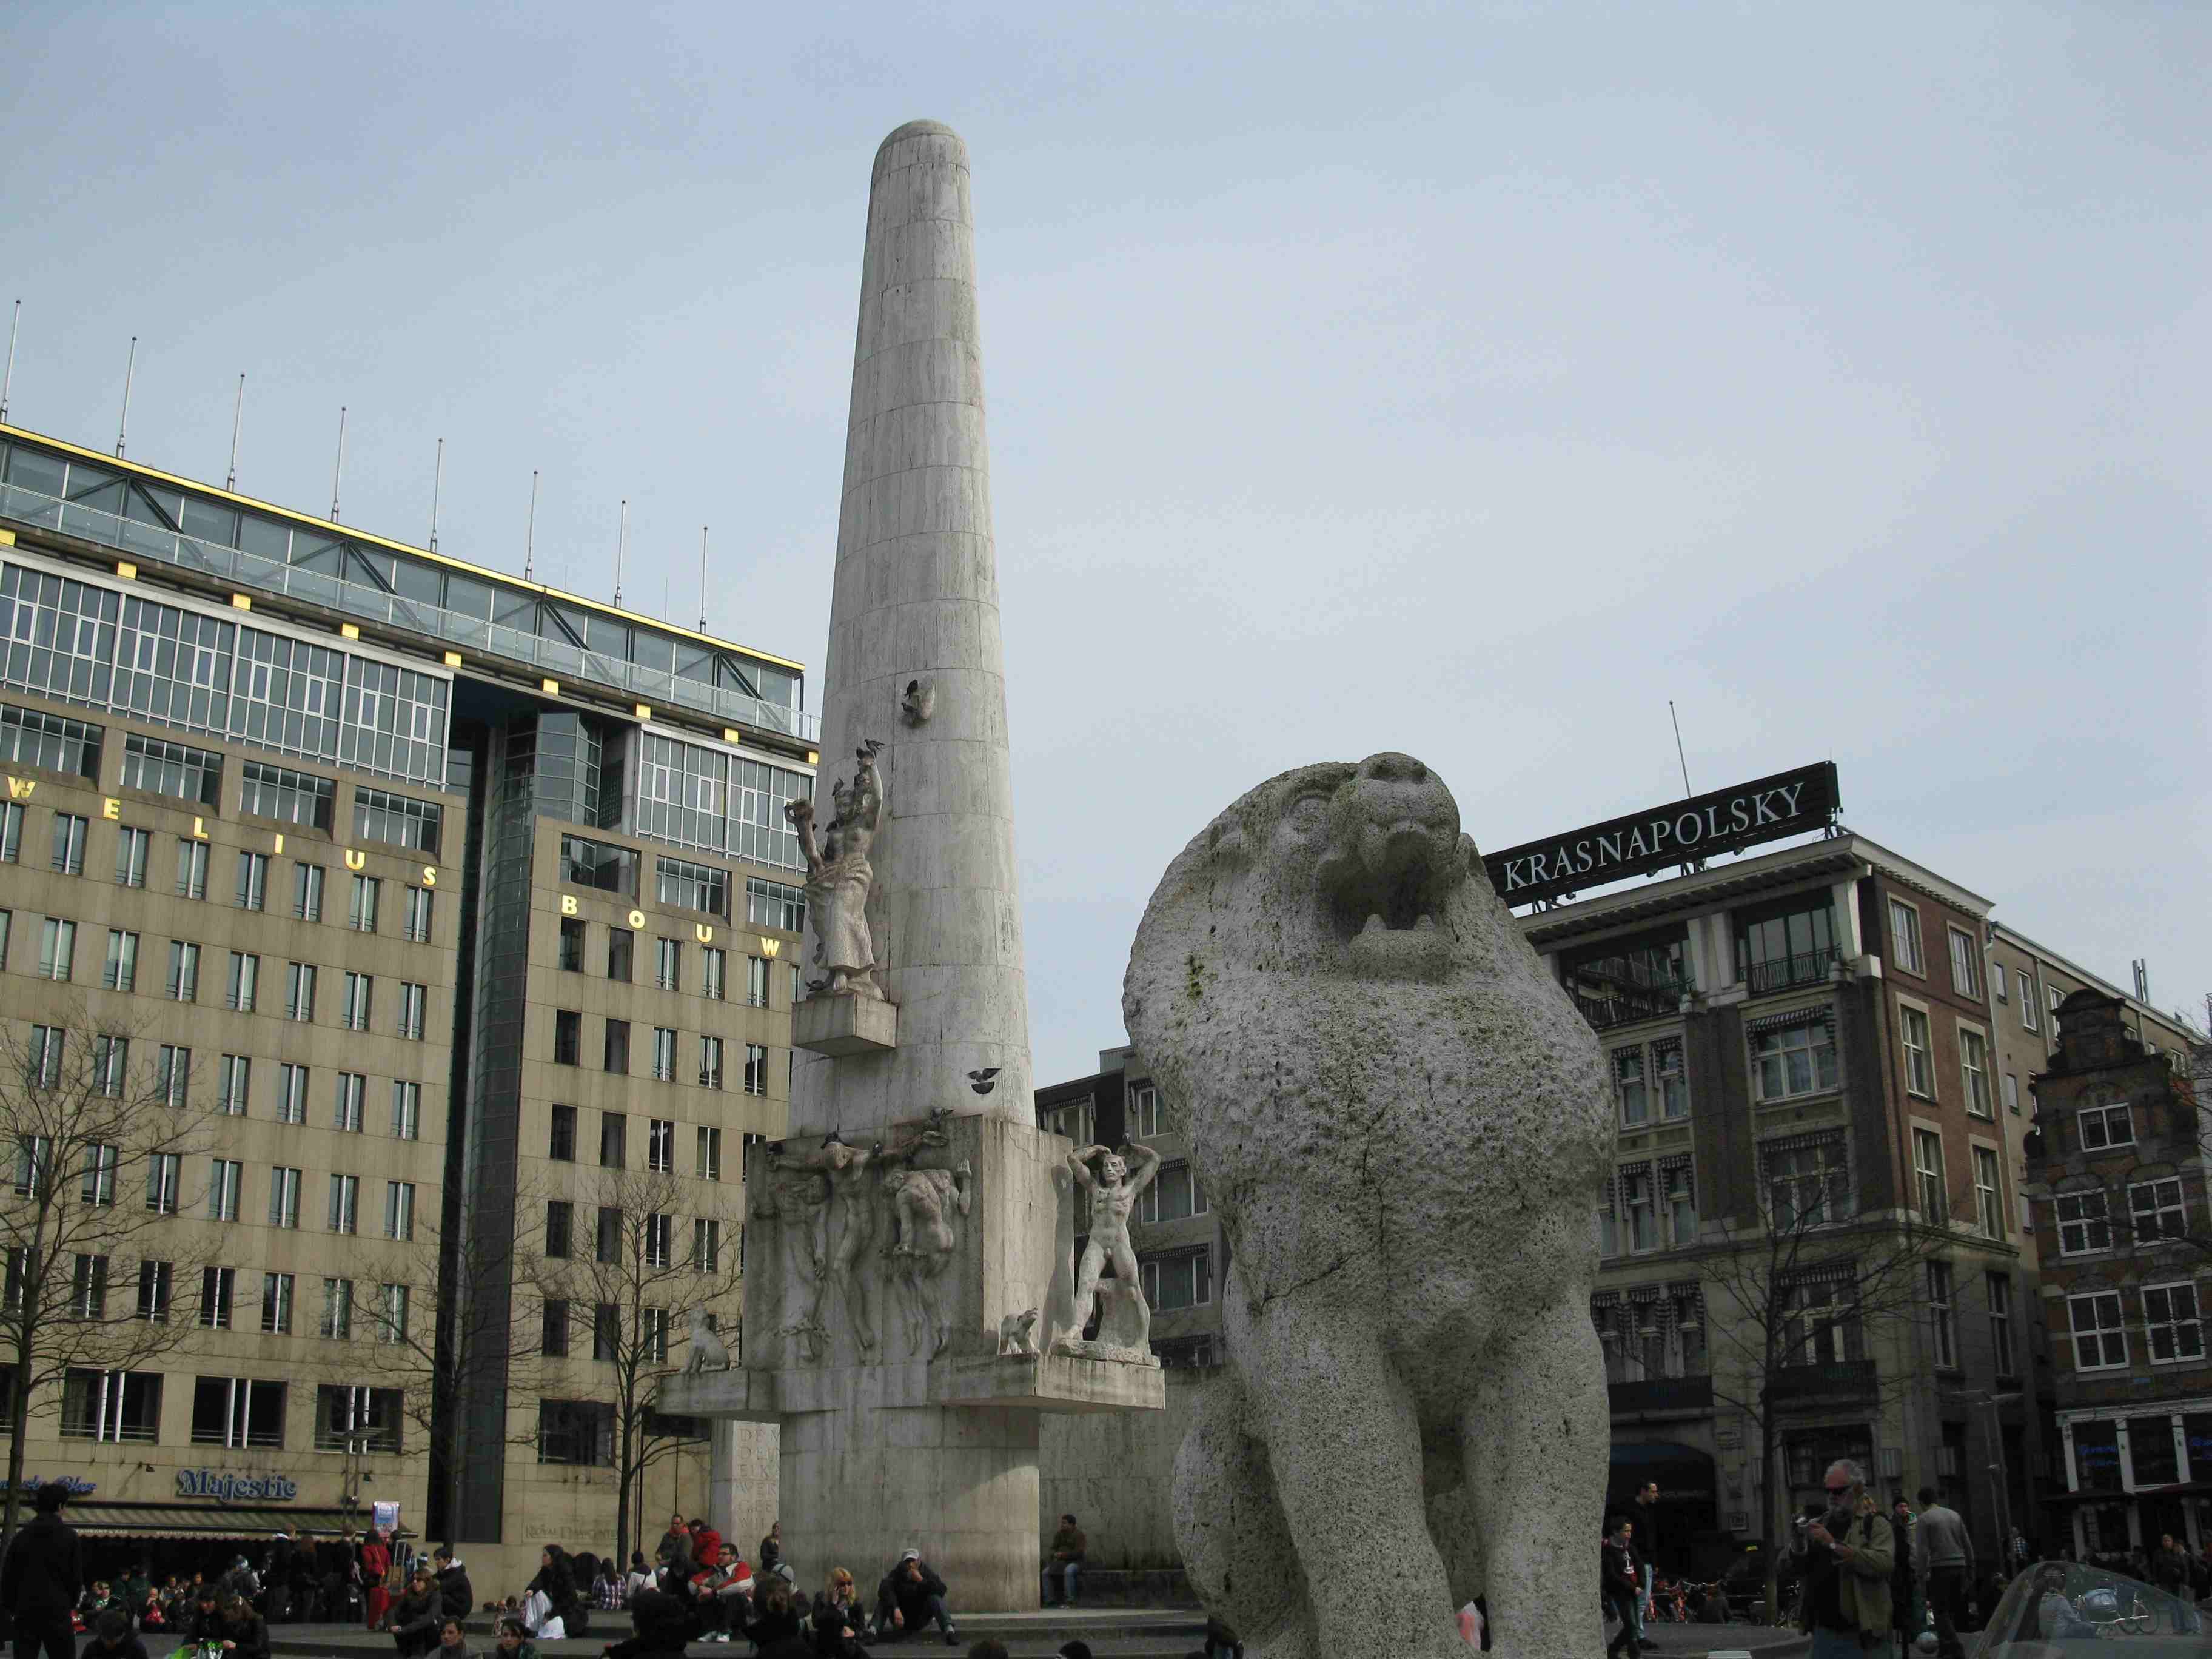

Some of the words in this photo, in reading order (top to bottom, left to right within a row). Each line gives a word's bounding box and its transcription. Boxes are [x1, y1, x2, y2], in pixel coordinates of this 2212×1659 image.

[1504, 782, 1805, 892] KRASNAPOLSKY
[561, 894, 780, 957] BOUW
[178, 1468, 297, 1501] Majestic
